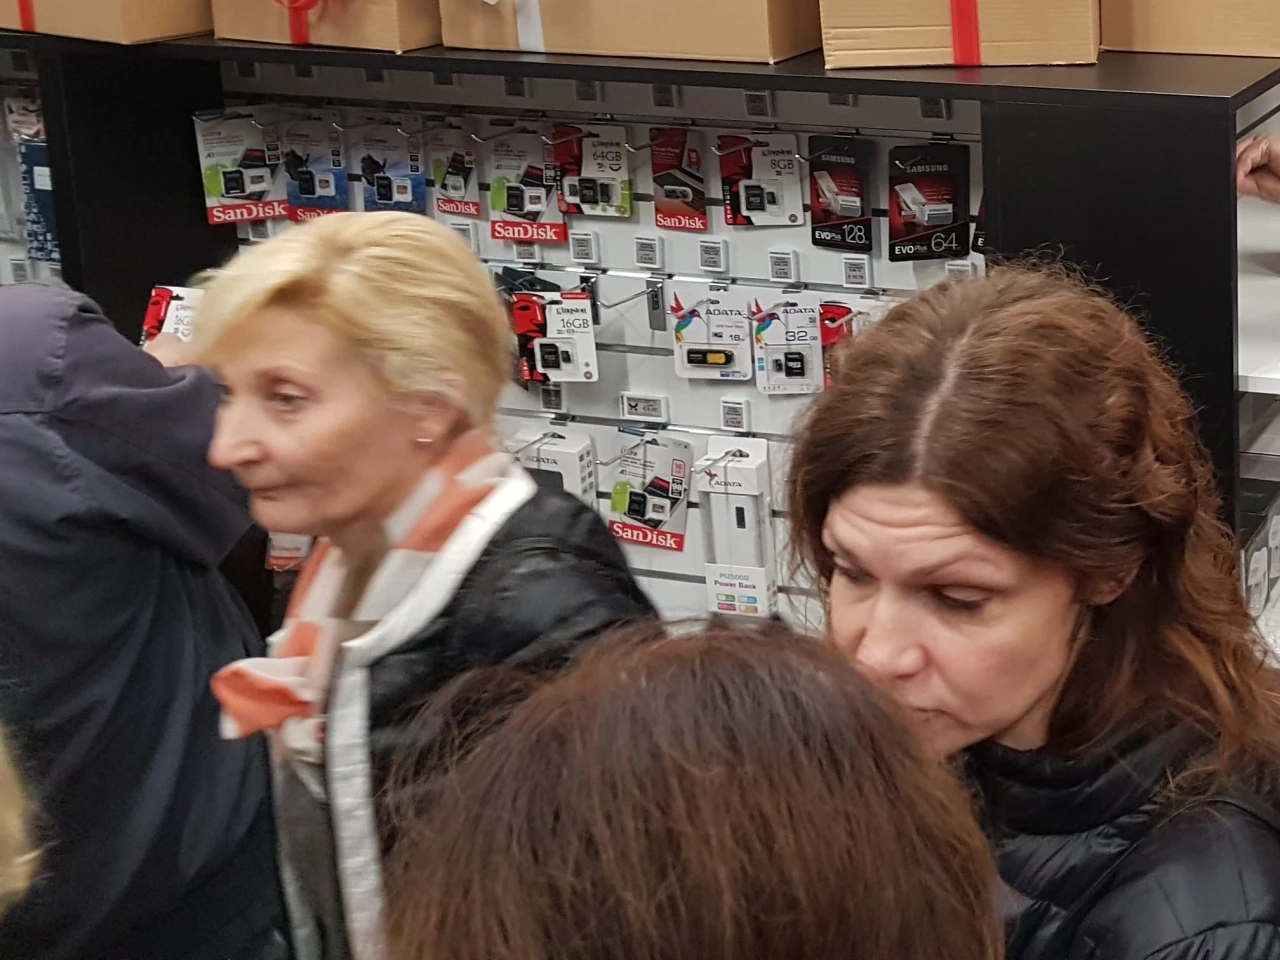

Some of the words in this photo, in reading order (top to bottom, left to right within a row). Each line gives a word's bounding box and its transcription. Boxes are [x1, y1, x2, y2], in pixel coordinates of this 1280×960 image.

[593, 150, 622, 162] 64GB
[762, 148, 793, 157] Kingston
[770, 159, 794, 170] 8GB
[821, 154, 856, 164] SAMSUNG
[906, 164, 949, 173] SAMSUNG
[213, 202, 288, 222] SanDisk
[438, 200, 479, 216] SanDisk
[656, 214, 705, 230] SanDisk
[494, 223, 559, 240] SanDisk
[842, 224, 866, 244] 128
[895, 245, 914, 255] EVO
[931, 232, 958, 252] 64
[556, 307, 587, 315] Kingston
[705, 308, 743, 316] ADATA
[561, 318, 590, 329] 16GB
[785, 330, 808, 342] 32
[612, 523, 678, 549] SanDisk
[714, 580, 737, 589] Power
[738, 582, 757, 590] Bank
